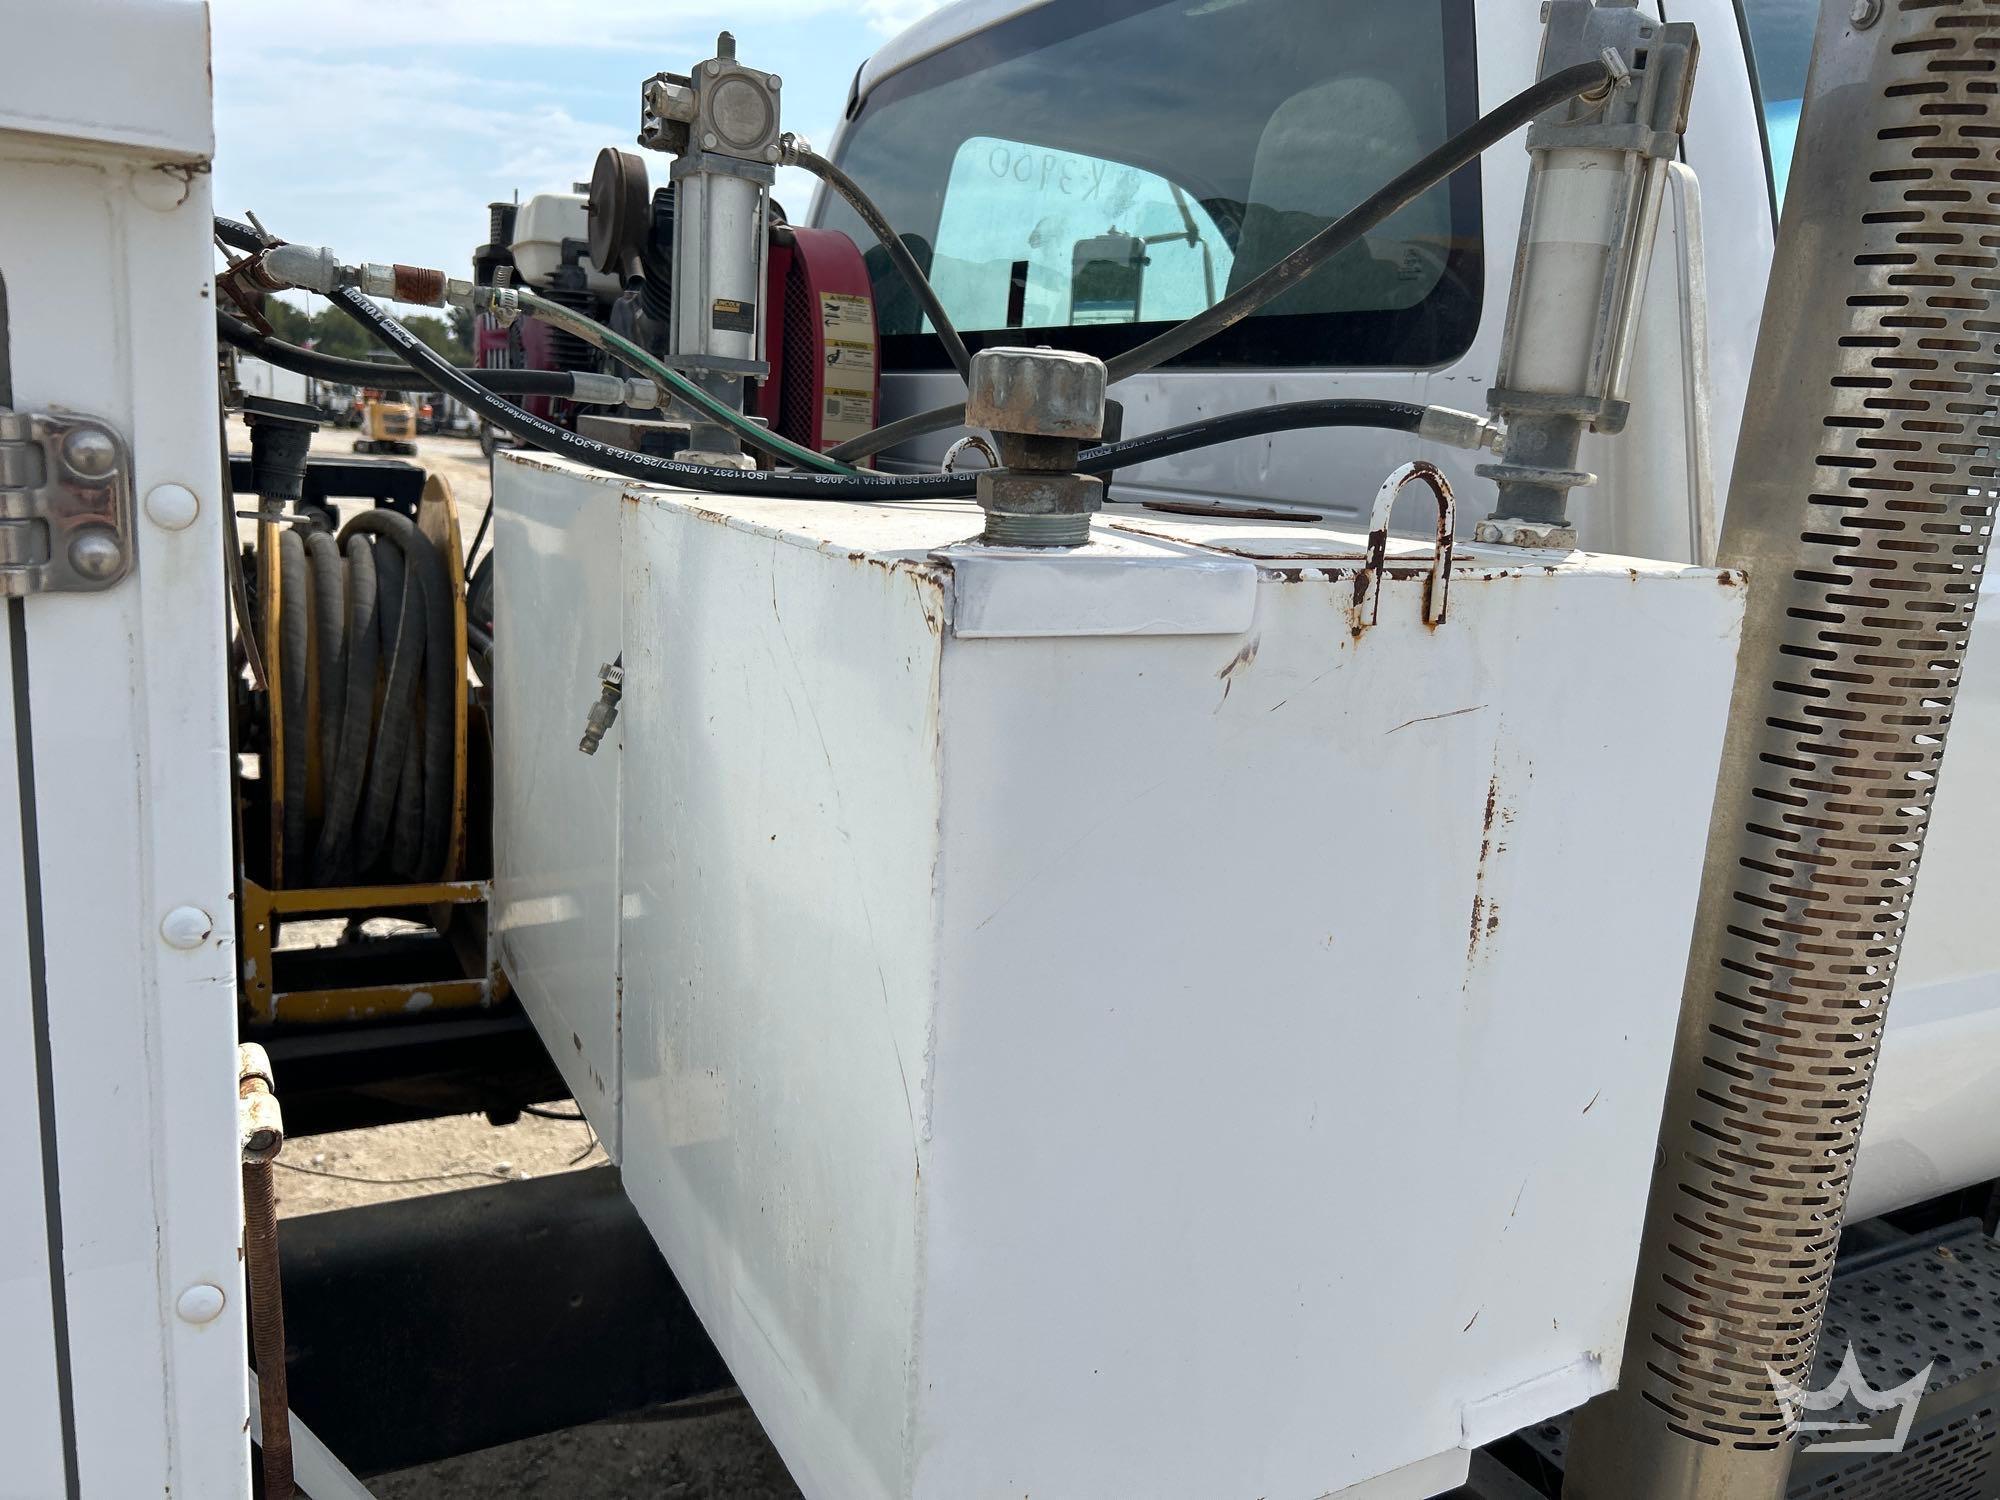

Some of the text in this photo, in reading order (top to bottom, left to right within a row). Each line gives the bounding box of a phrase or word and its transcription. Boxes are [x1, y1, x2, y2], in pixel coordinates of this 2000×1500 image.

[342, 287, 384, 321] TOUGH
[381, 319, 416, 348] Parker
[484, 394, 556, 435] www.parker.com
[863, 476, 896, 485] MSHA
